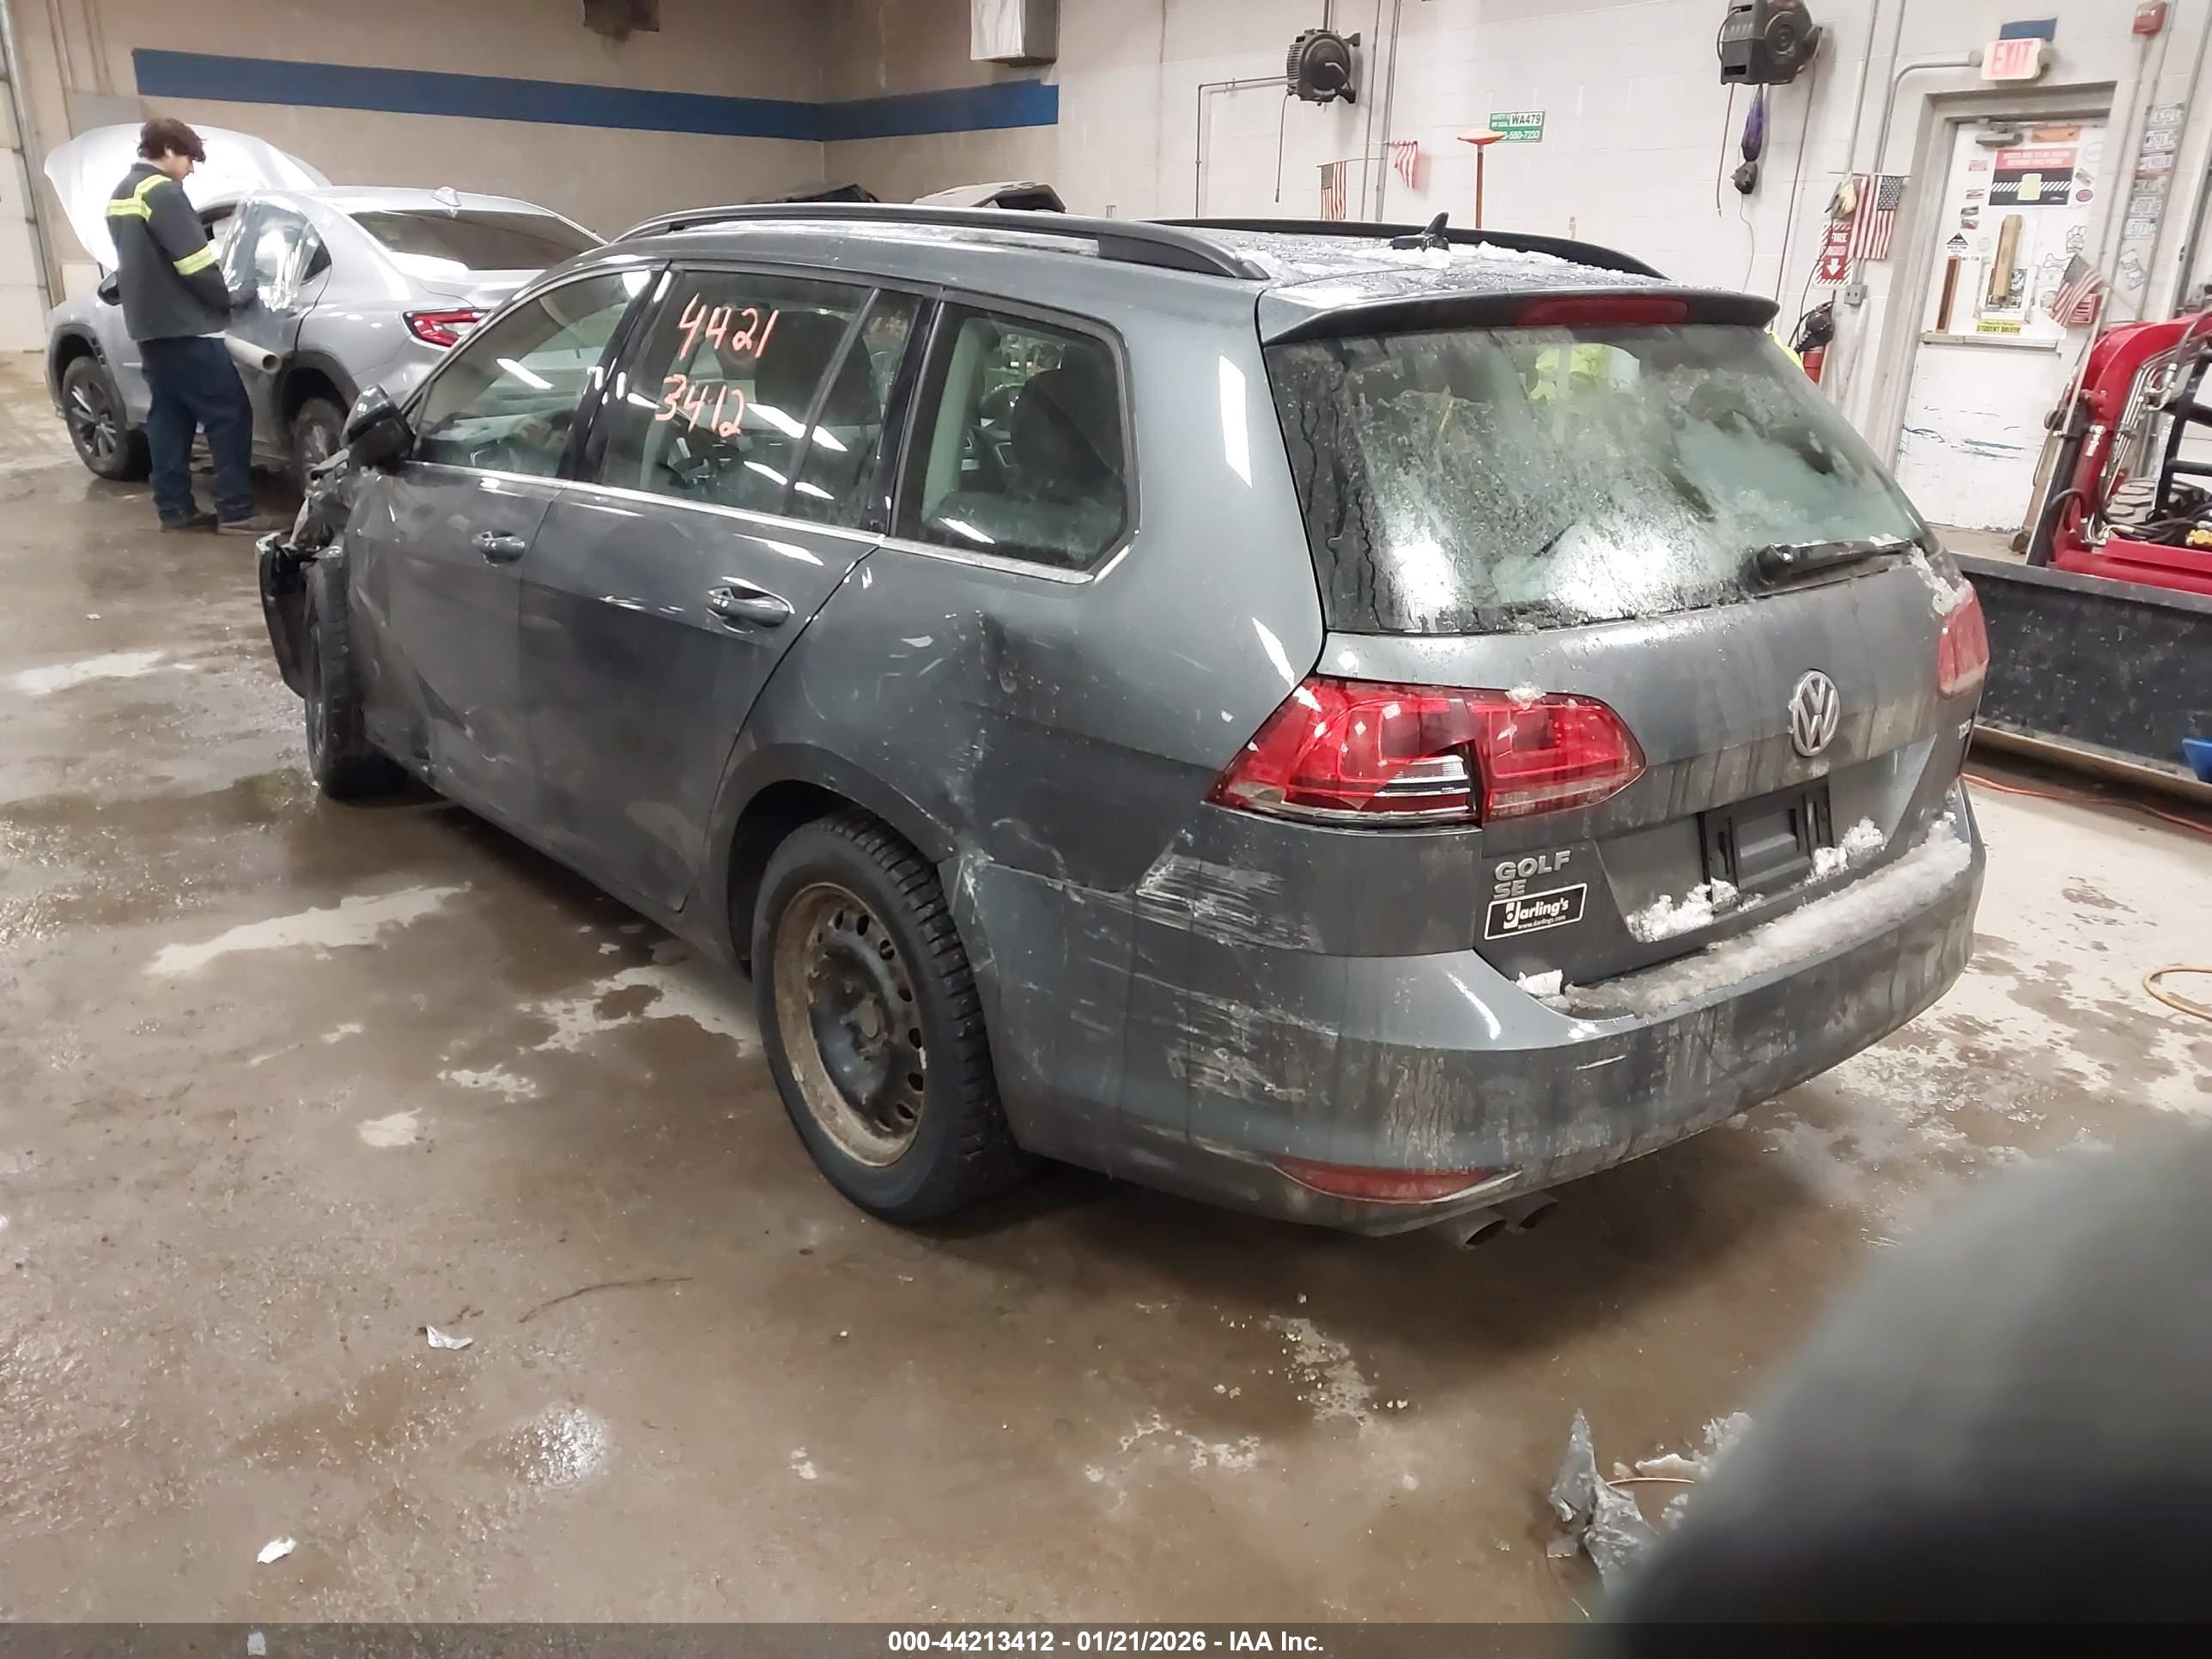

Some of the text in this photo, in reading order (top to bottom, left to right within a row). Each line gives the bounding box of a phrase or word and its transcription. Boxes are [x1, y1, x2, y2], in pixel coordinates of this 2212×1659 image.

[1991, 40, 2033, 76] EXIT
[1512, 113, 1540, 125] WA479
[678, 292, 780, 361] 4421
[655, 374, 743, 437] 3412
[1495, 850, 1571, 881] GOLF
[1493, 879, 1527, 899] SE
